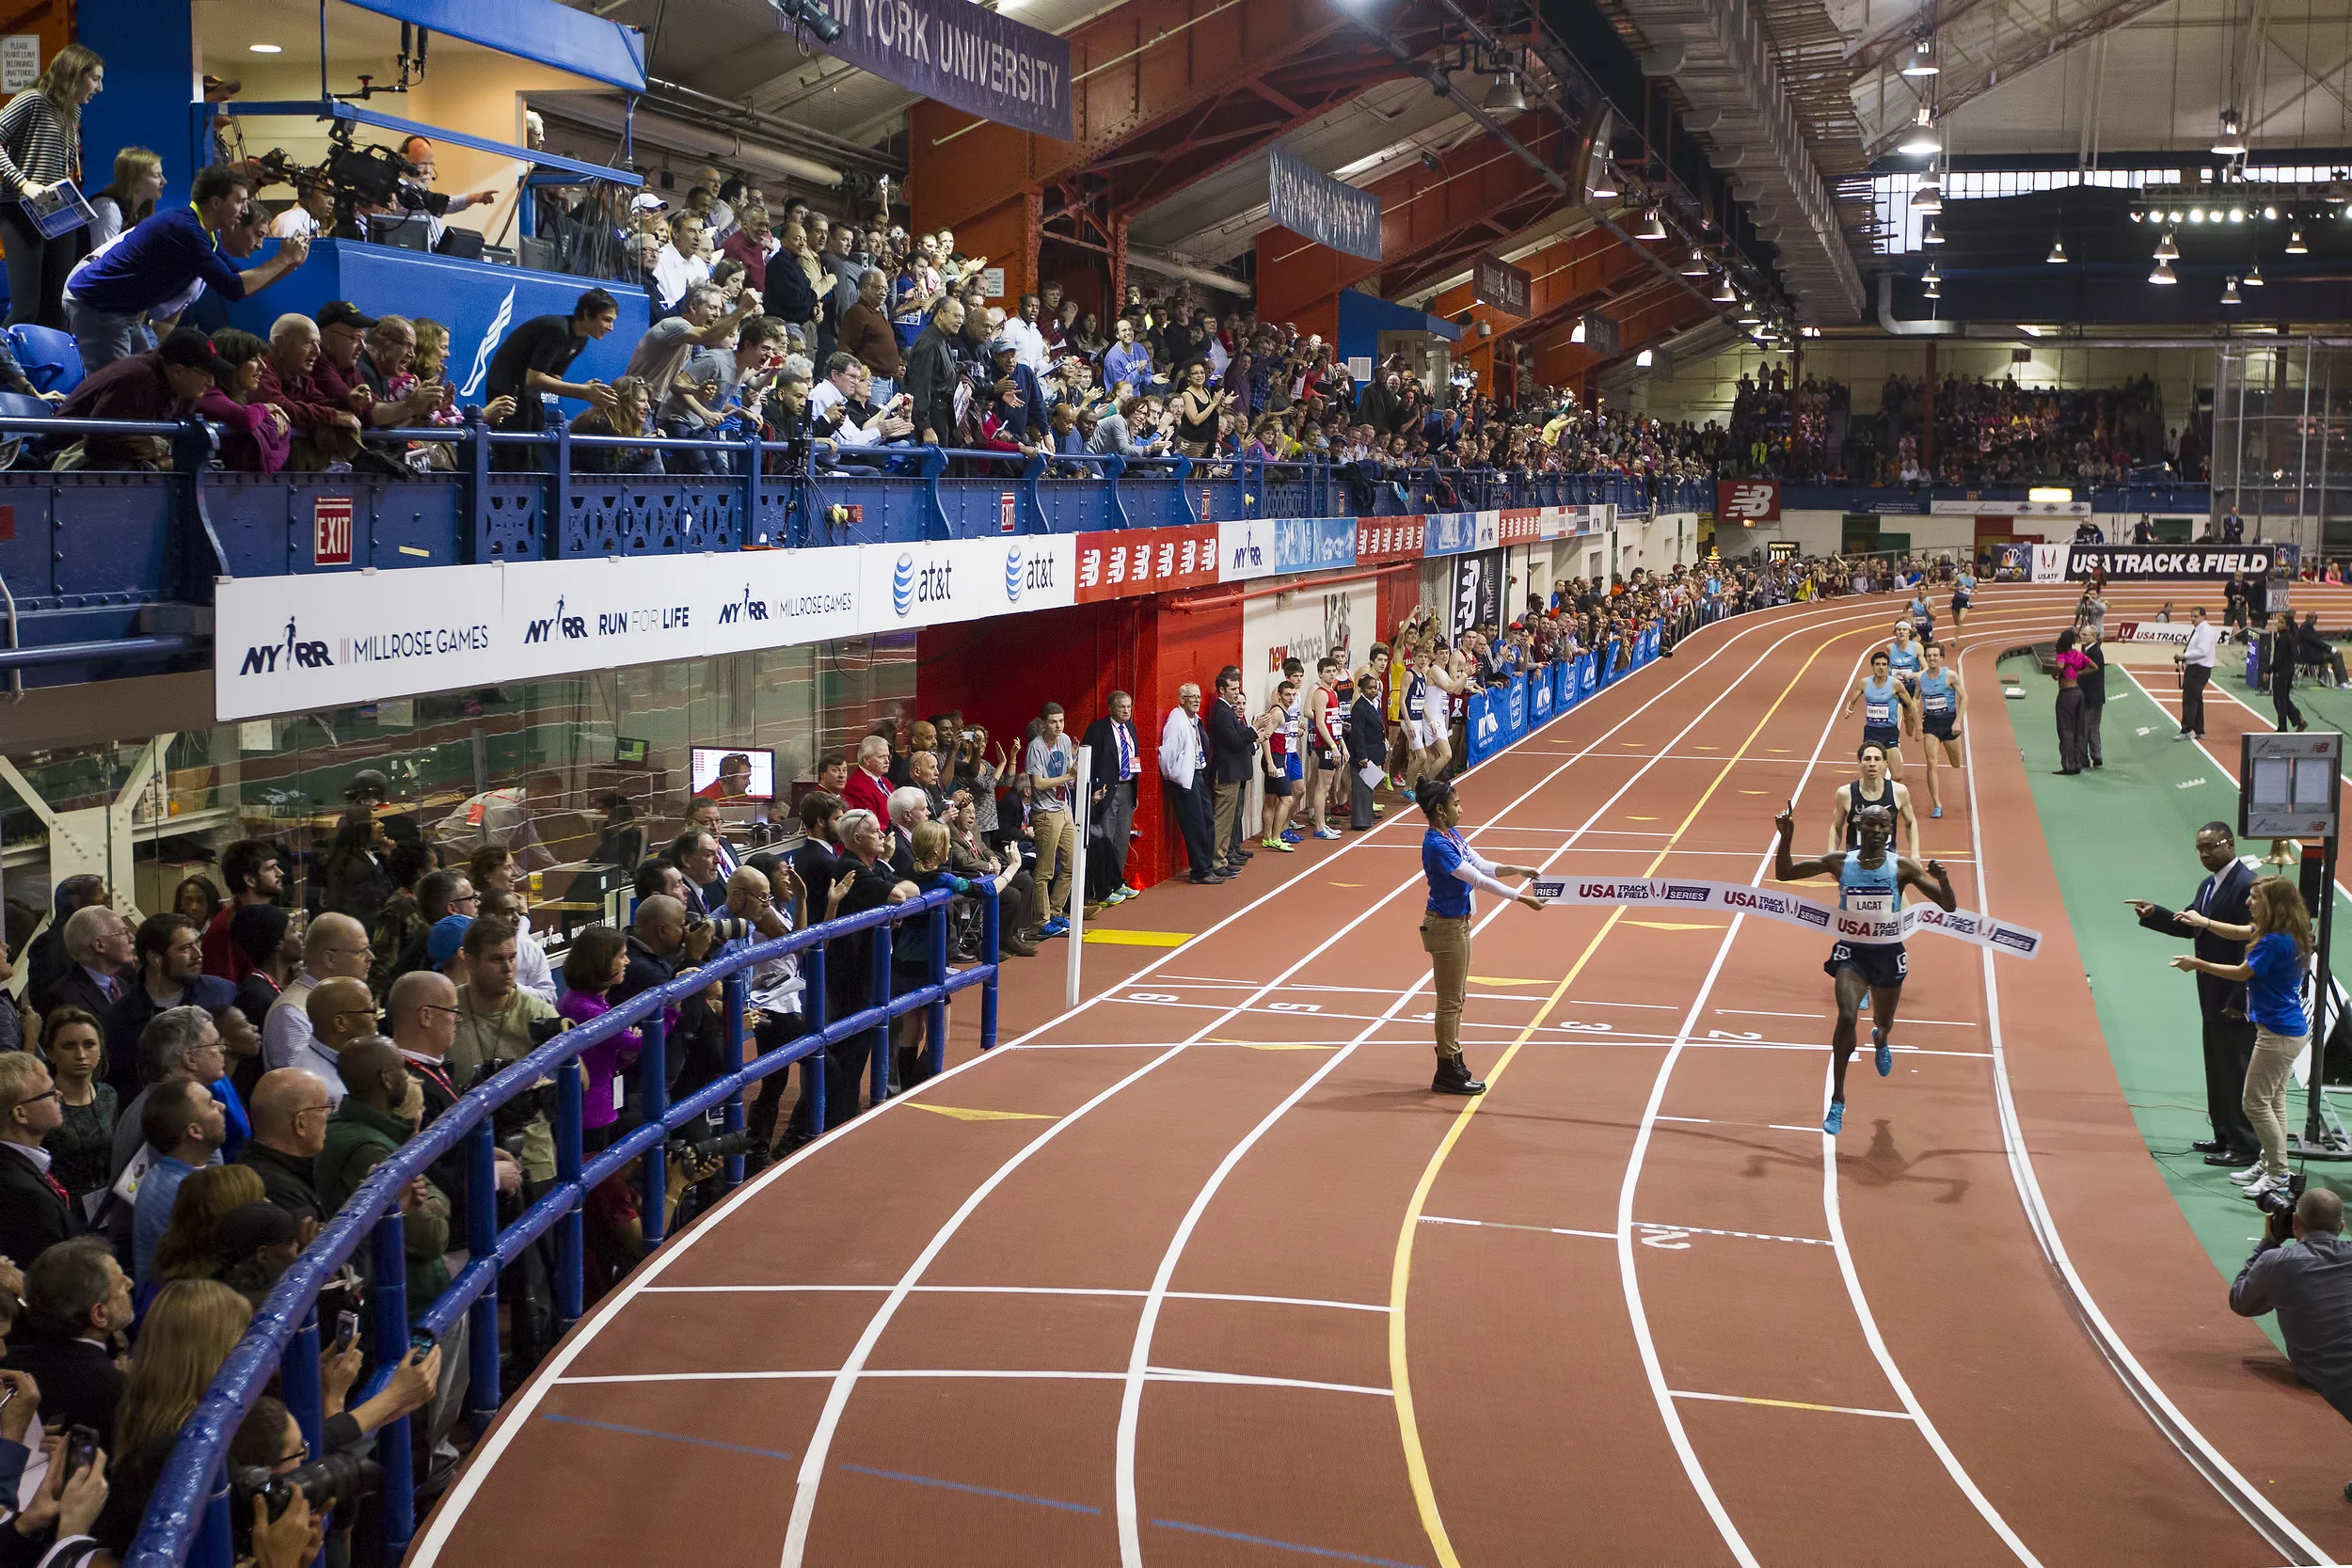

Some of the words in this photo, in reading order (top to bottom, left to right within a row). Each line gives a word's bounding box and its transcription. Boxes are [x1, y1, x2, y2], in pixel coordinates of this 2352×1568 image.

[865, 0, 930, 65] YORK
[940, 20, 1058, 109] UNIVERSITY
[540, 392, 560, 404] enter
[1001, 503, 1014, 526] EXIT
[317, 516, 350, 555] EXIT
[1233, 546, 1263, 569] NYRR
[2114, 553, 2182, 574] TRACK
[2185, 554, 2201, 574] &
[2202, 553, 2268, 574] FIELD
[1026, 551, 1055, 590] at&t
[918, 560, 952, 603] at&t
[719, 600, 770, 625] NYRR
[780, 595, 822, 618] MILLROSE
[823, 593, 851, 613] GAMES
[524, 616, 588, 643] NYRR
[598, 612, 628, 636] RUN
[631, 609, 659, 633] FOR
[662, 607, 690, 629] LIFE
[2136, 631, 2155, 640] USA
[2156, 632, 2190, 642] TRACK
[239, 641, 335, 676] NYRR
[354, 630, 433, 663] MILLROSE
[436, 625, 488, 656] GAMES
[1268, 644, 1289, 673] new
[1534, 888, 1559, 896] ERIES
[1579, 884, 1616, 898] USA
[1669, 891, 1705, 900] SERIES
[1724, 890, 1757, 909] USA
[1759, 896, 1785, 908] TRACK
[1856, 900, 1883, 911] LAGAT
[1764, 904, 1785, 914] FIELD
[1800, 911, 1826, 926] SERIES
[1916, 910, 1944, 927] USA
[1948, 914, 1977, 927] TRACK
[1837, 917, 1871, 937] USA
[1871, 927, 1879, 937] &
[1880, 927, 1899, 937] FIELD
[1873, 922, 1899, 930] TRACK
[1948, 922, 1975, 935] FIELD
[1994, 934, 2032, 950] SERIES
[1128, 992, 1179, 1003] 6
[1268, 1002, 1322, 1012] 5
[1560, 1021, 1613, 1032] 3
[1708, 1029, 1762, 1041] 2
